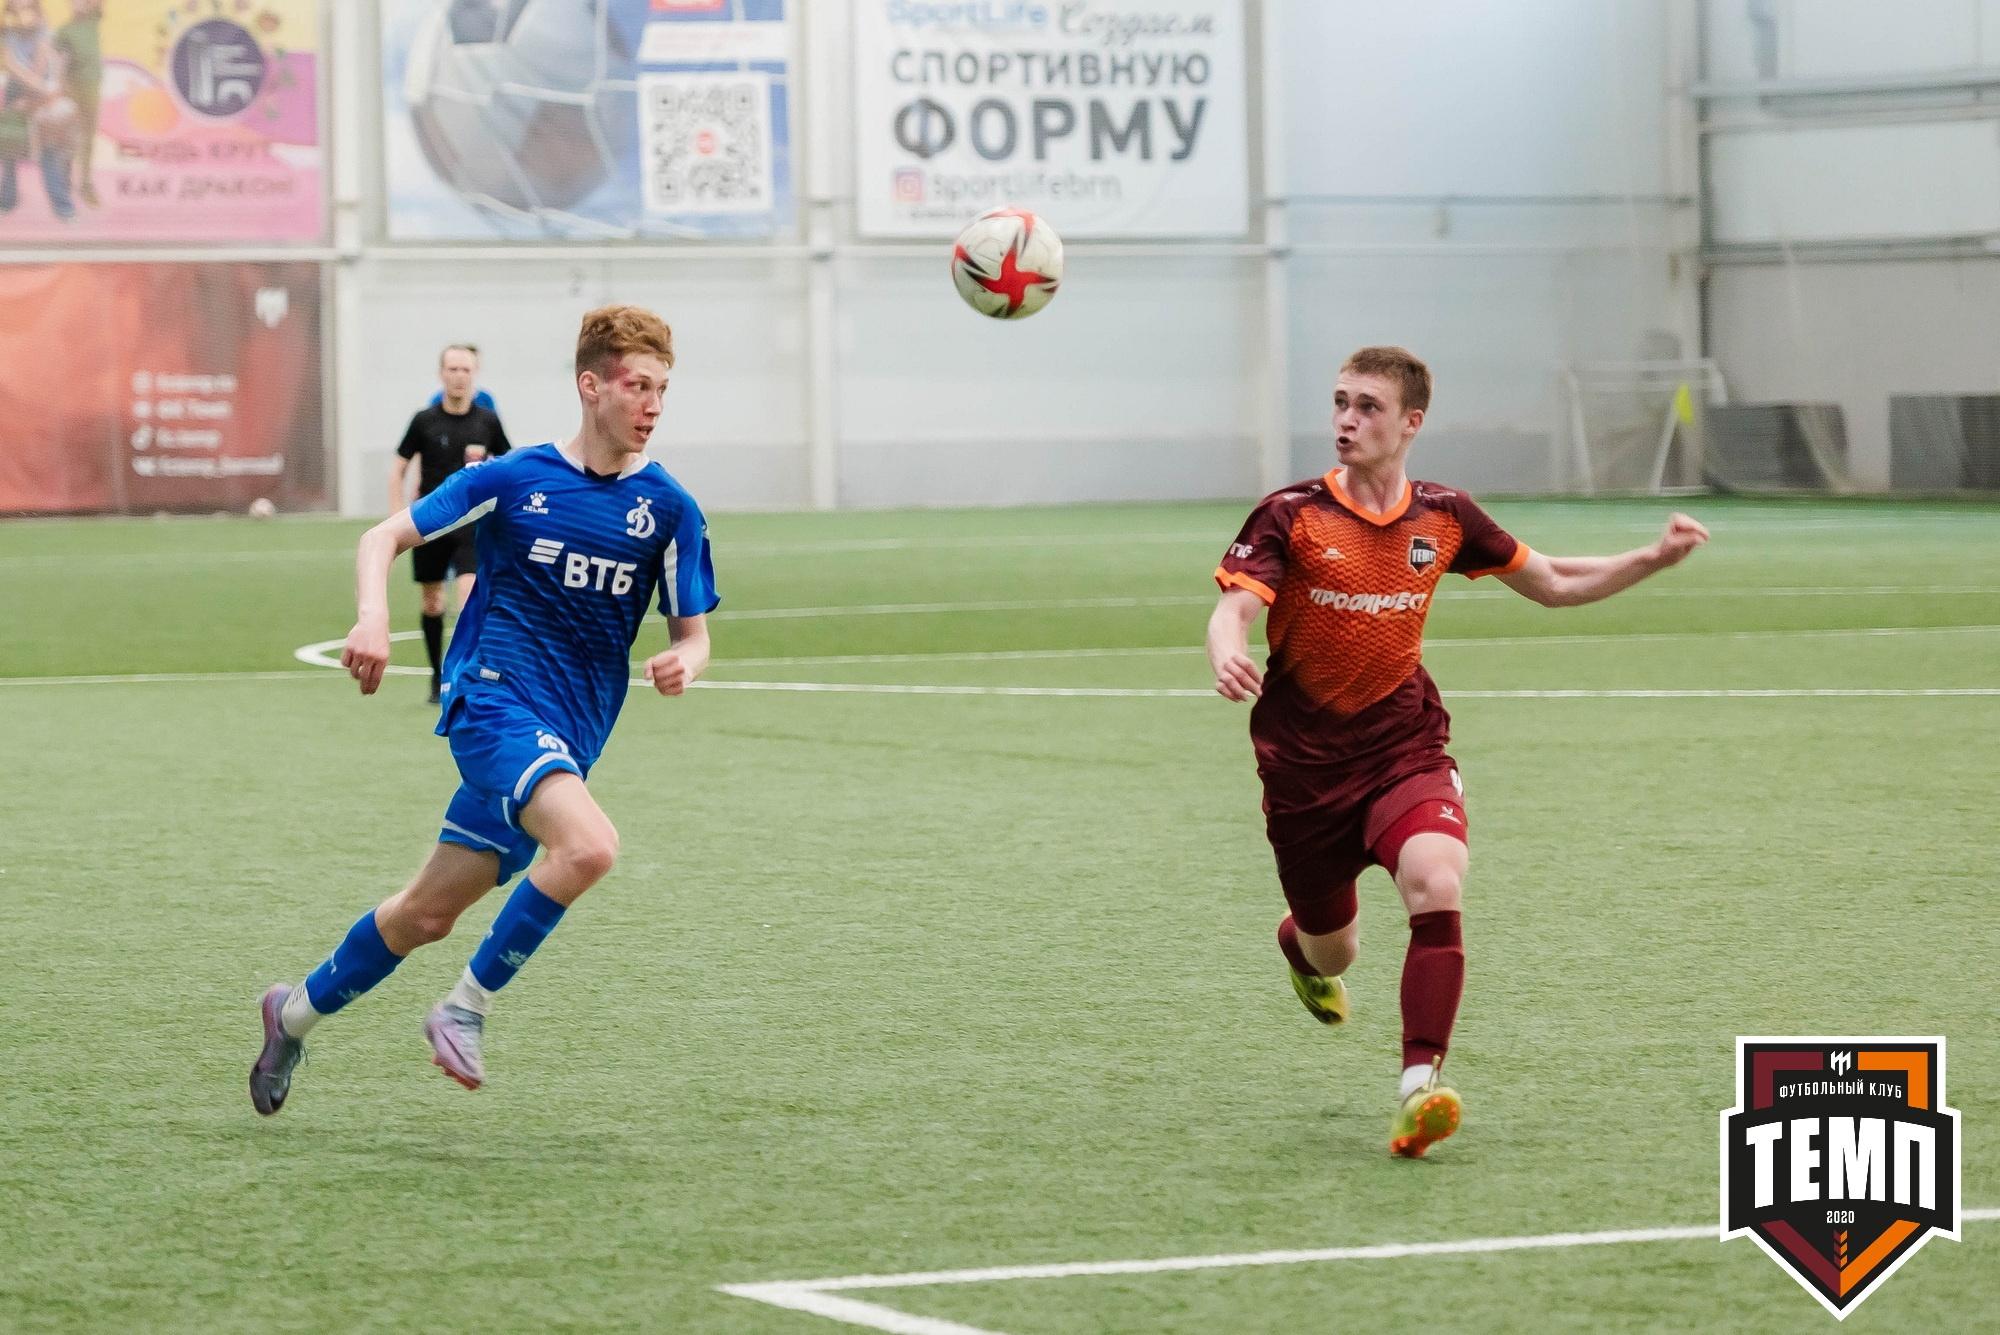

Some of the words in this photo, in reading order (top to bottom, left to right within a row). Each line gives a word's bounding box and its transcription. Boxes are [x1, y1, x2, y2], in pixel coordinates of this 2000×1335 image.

[892, 49, 1211, 86] СПОРТИВНУЮ
[894, 97, 1206, 161] ФОРМУ
[116, 178, 168, 197] КАК
[522, 504, 549, 515] KELME
[564, 552, 637, 595] ВТБ
